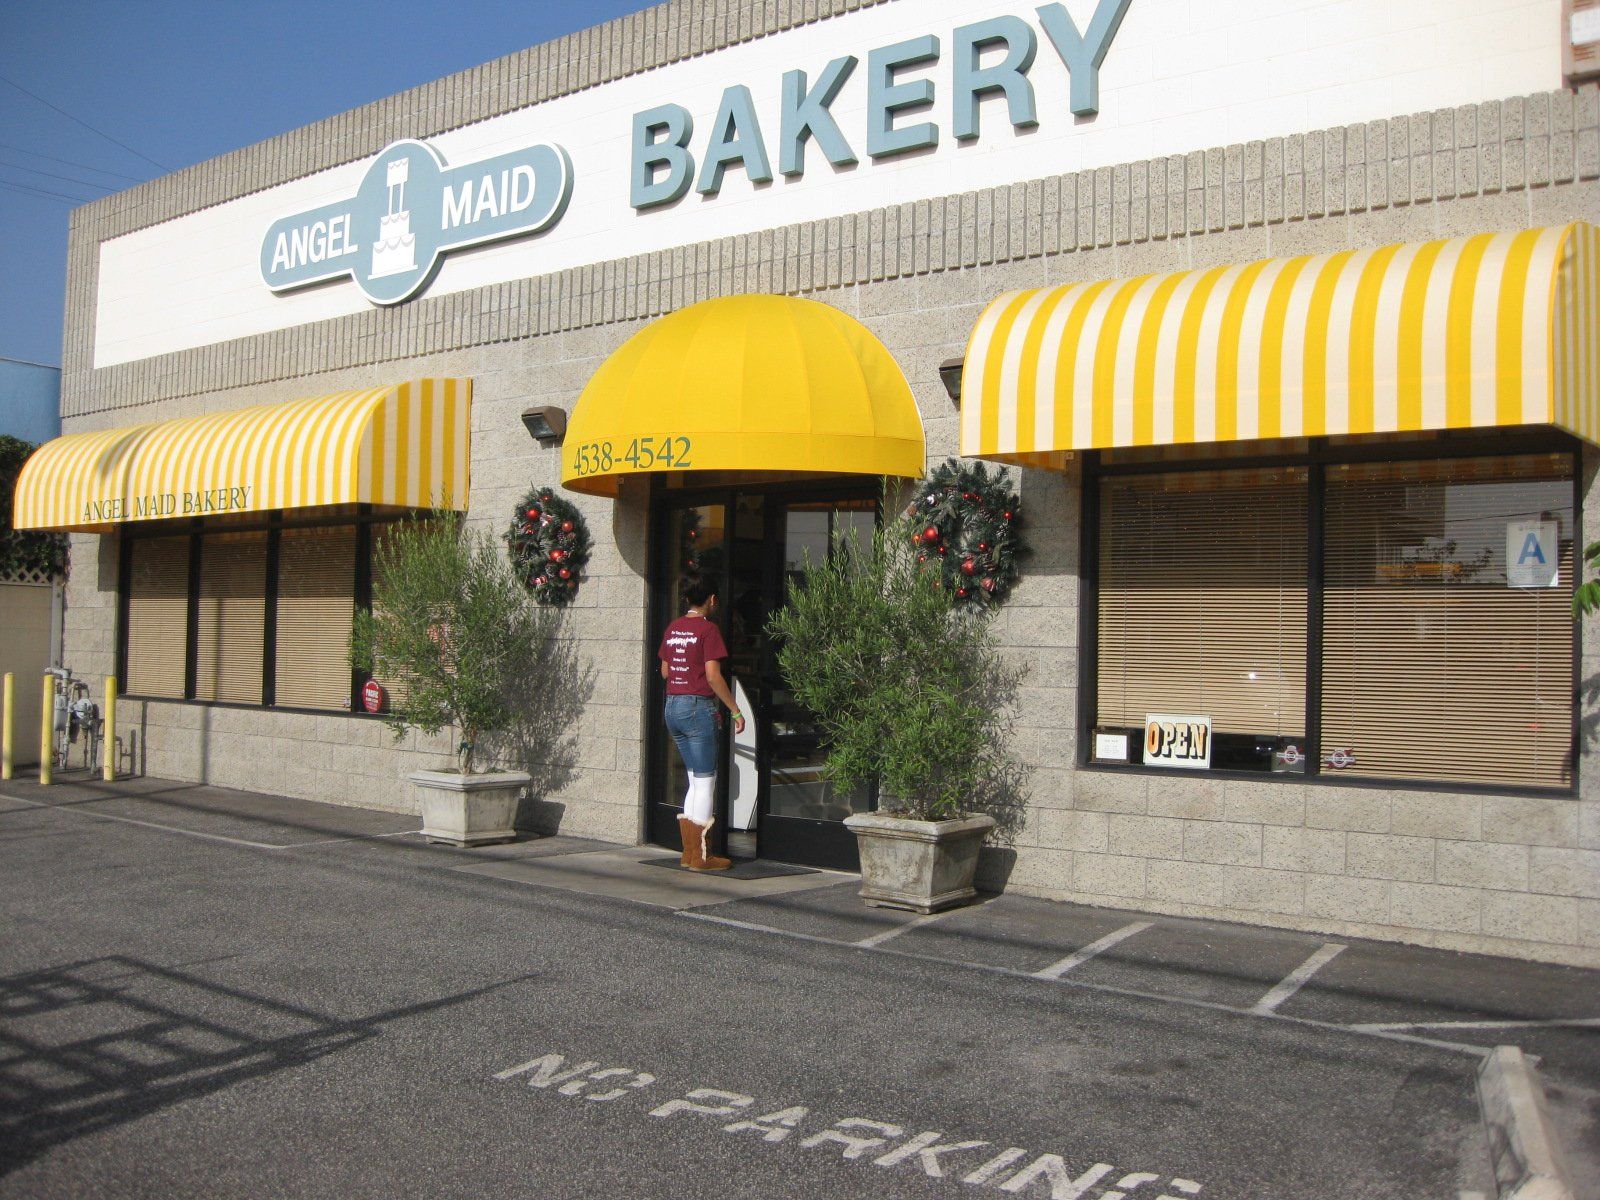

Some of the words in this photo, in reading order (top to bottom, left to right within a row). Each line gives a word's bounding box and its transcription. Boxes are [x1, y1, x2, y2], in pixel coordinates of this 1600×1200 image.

[630, 0, 1133, 209] BAKERY
[270, 213, 359, 273] ANGEL
[441, 164, 537, 231] MAID
[573, 436, 691, 476] 4538-4542
[83, 498, 130, 522] ANGEL
[134, 493, 177, 517] MAID
[182, 486, 251, 513] BAKERY
[1517, 532, 1546, 564] A
[1147, 721, 1208, 760] OPEN
[492, 1053, 656, 1101] NO
